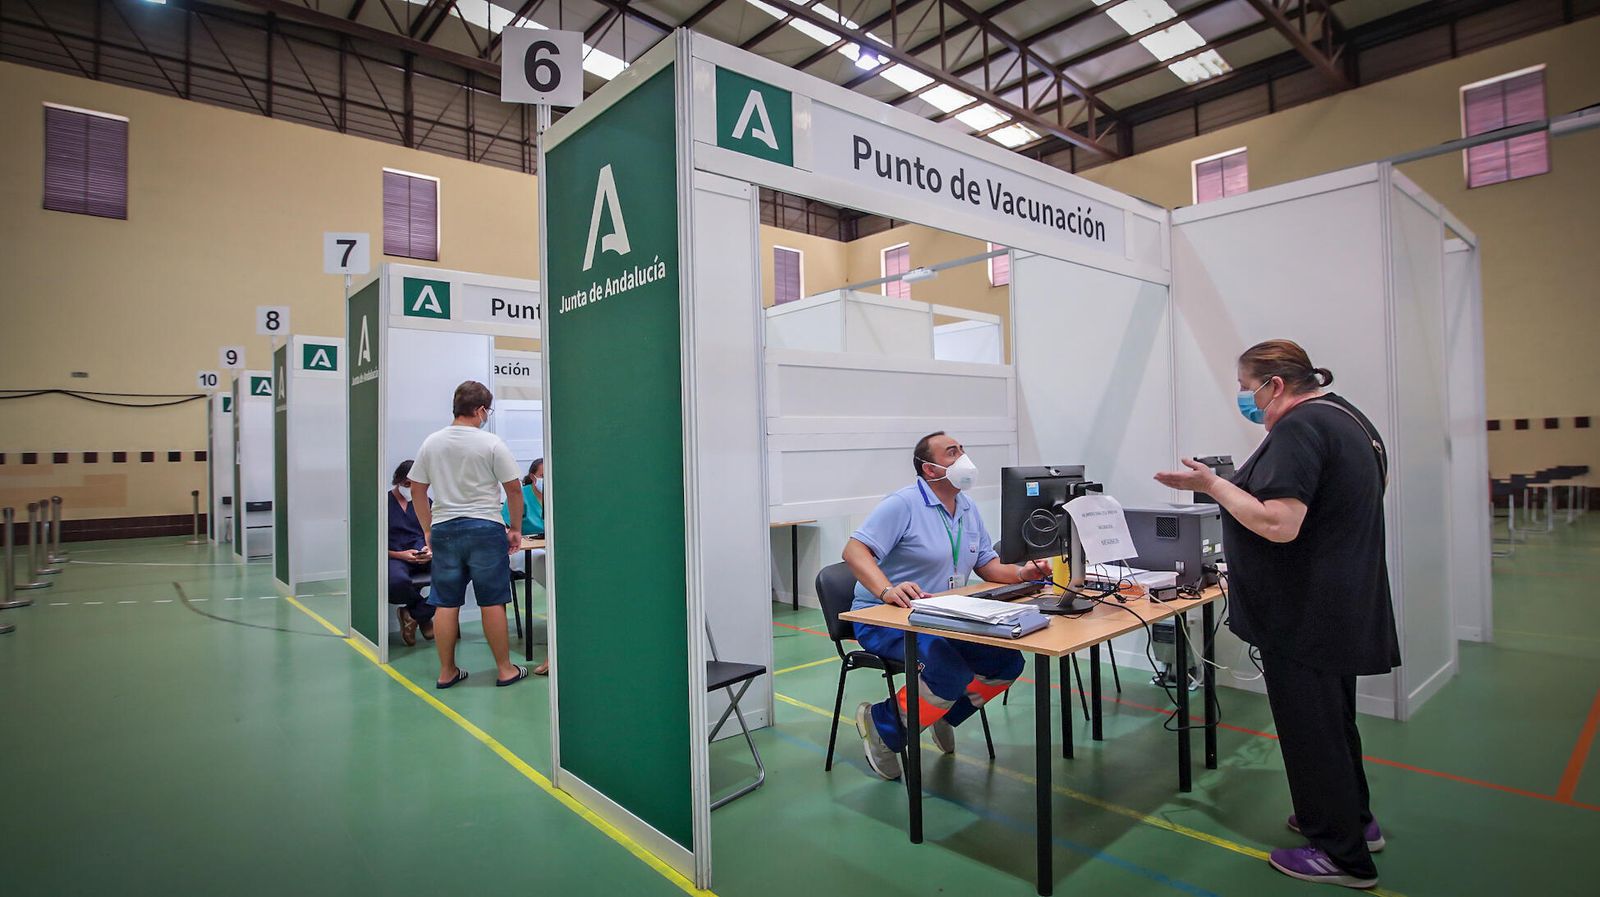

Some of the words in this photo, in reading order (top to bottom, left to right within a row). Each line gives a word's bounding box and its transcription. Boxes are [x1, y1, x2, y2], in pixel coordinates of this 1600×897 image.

[524, 40, 561, 92] 6
[853, 134, 942, 193] Punto
[950, 167, 981, 205] de
[986, 178, 1106, 242] Vacunación
[336, 239, 357, 267] 7
[559, 289, 588, 314] Junta
[589, 282, 603, 303] de
[604, 254, 666, 298] Andalucía
[265, 310, 280, 331] 8
[226, 349, 238, 366] 9
[199, 373, 218, 387] 10
